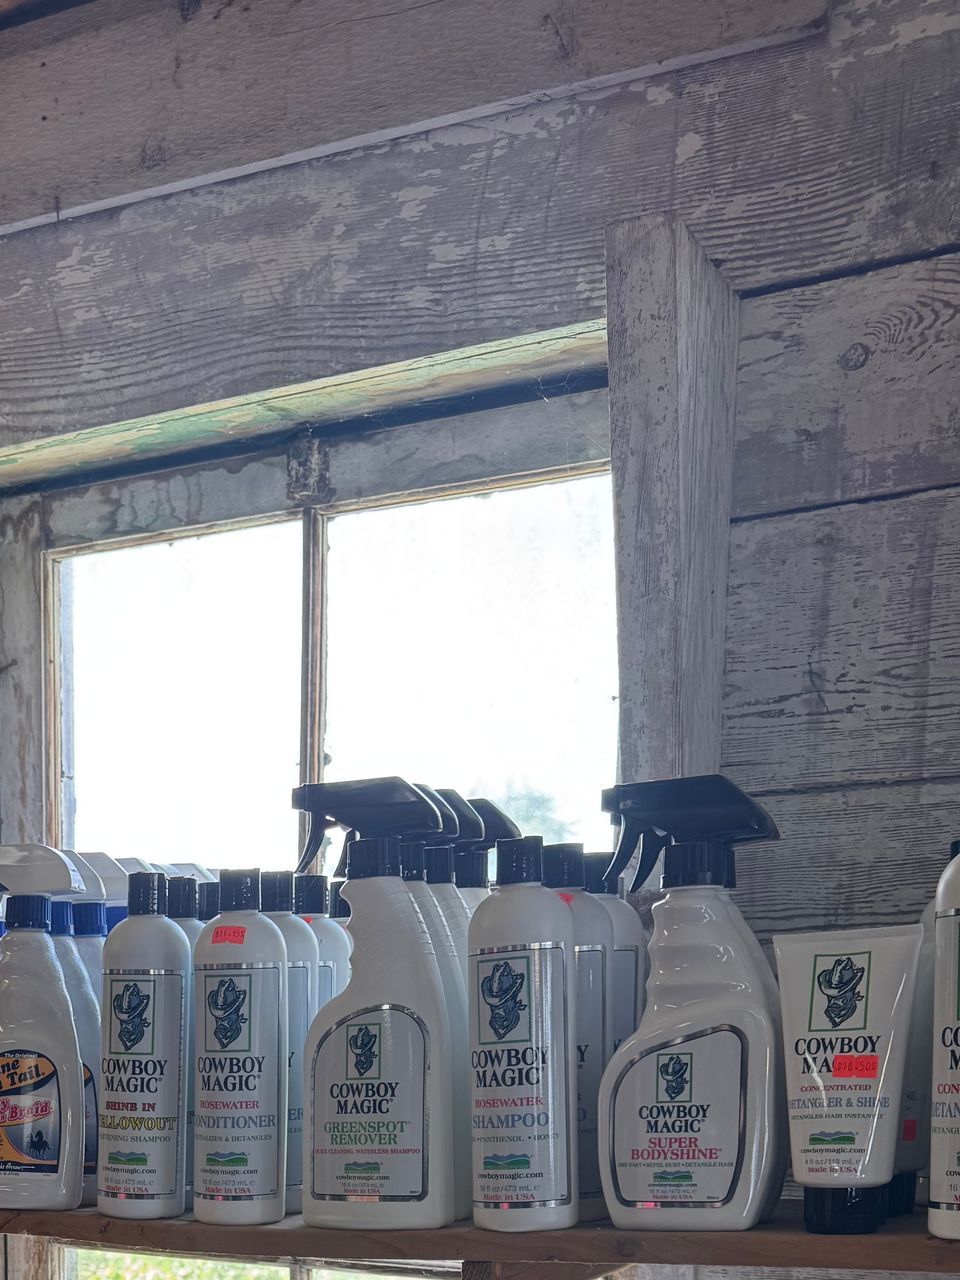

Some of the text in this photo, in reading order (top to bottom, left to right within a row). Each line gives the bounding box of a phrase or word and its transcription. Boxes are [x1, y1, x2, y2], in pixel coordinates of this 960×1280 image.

[794, 1035, 881, 1056] COWBOY
[198, 1056, 265, 1074] COWBOY
[472, 1046, 549, 1069] COWBOY
[102, 1059, 167, 1075] COWBOY
[7, 1064, 41, 1087] Tail
[330, 1082, 399, 1099] COWBOY
[105, 1101, 156, 1112] SHINE IN
[475, 1096, 543, 1109] ROSEWATER
[857, 1097, 890, 1108] SHINE
[9, 1100, 51, 1121] Braid
[639, 1104, 710, 1119] COWBOY
[472, 1112, 549, 1129] SHAMPOO
[131, 1135, 171, 1143] SHAMPOO
[231, 1133, 273, 1141] DETANGLES
[330, 1133, 398, 1145] REMOVER
[648, 1137, 699, 1148] SUPER
[631, 1148, 719, 1160] BODYSHINE
